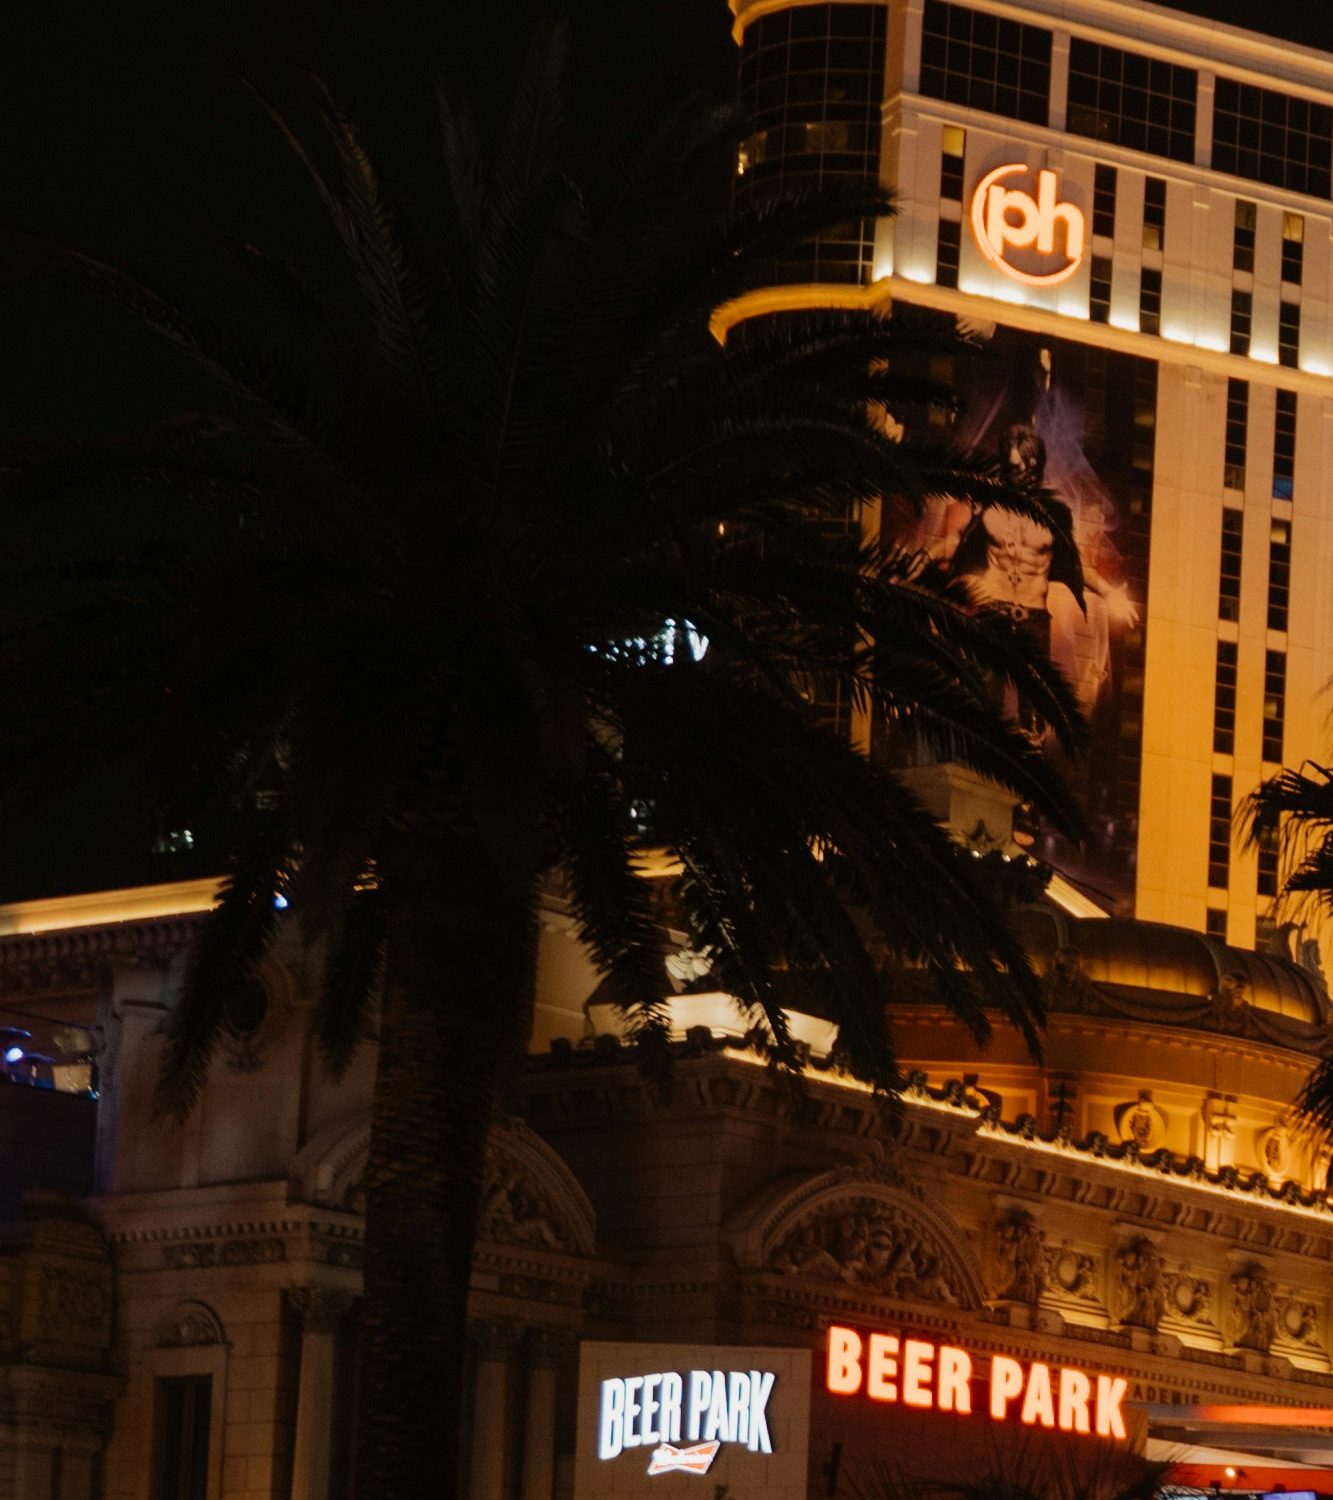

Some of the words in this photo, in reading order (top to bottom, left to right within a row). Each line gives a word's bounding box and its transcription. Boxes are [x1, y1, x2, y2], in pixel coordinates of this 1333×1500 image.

[987, 169, 1086, 260] ph
[599, 1371, 684, 1461] BEER
[687, 1370, 775, 1455] PARK
[825, 1325, 972, 1415] BEER
[989, 1355, 1128, 1440] PARK
